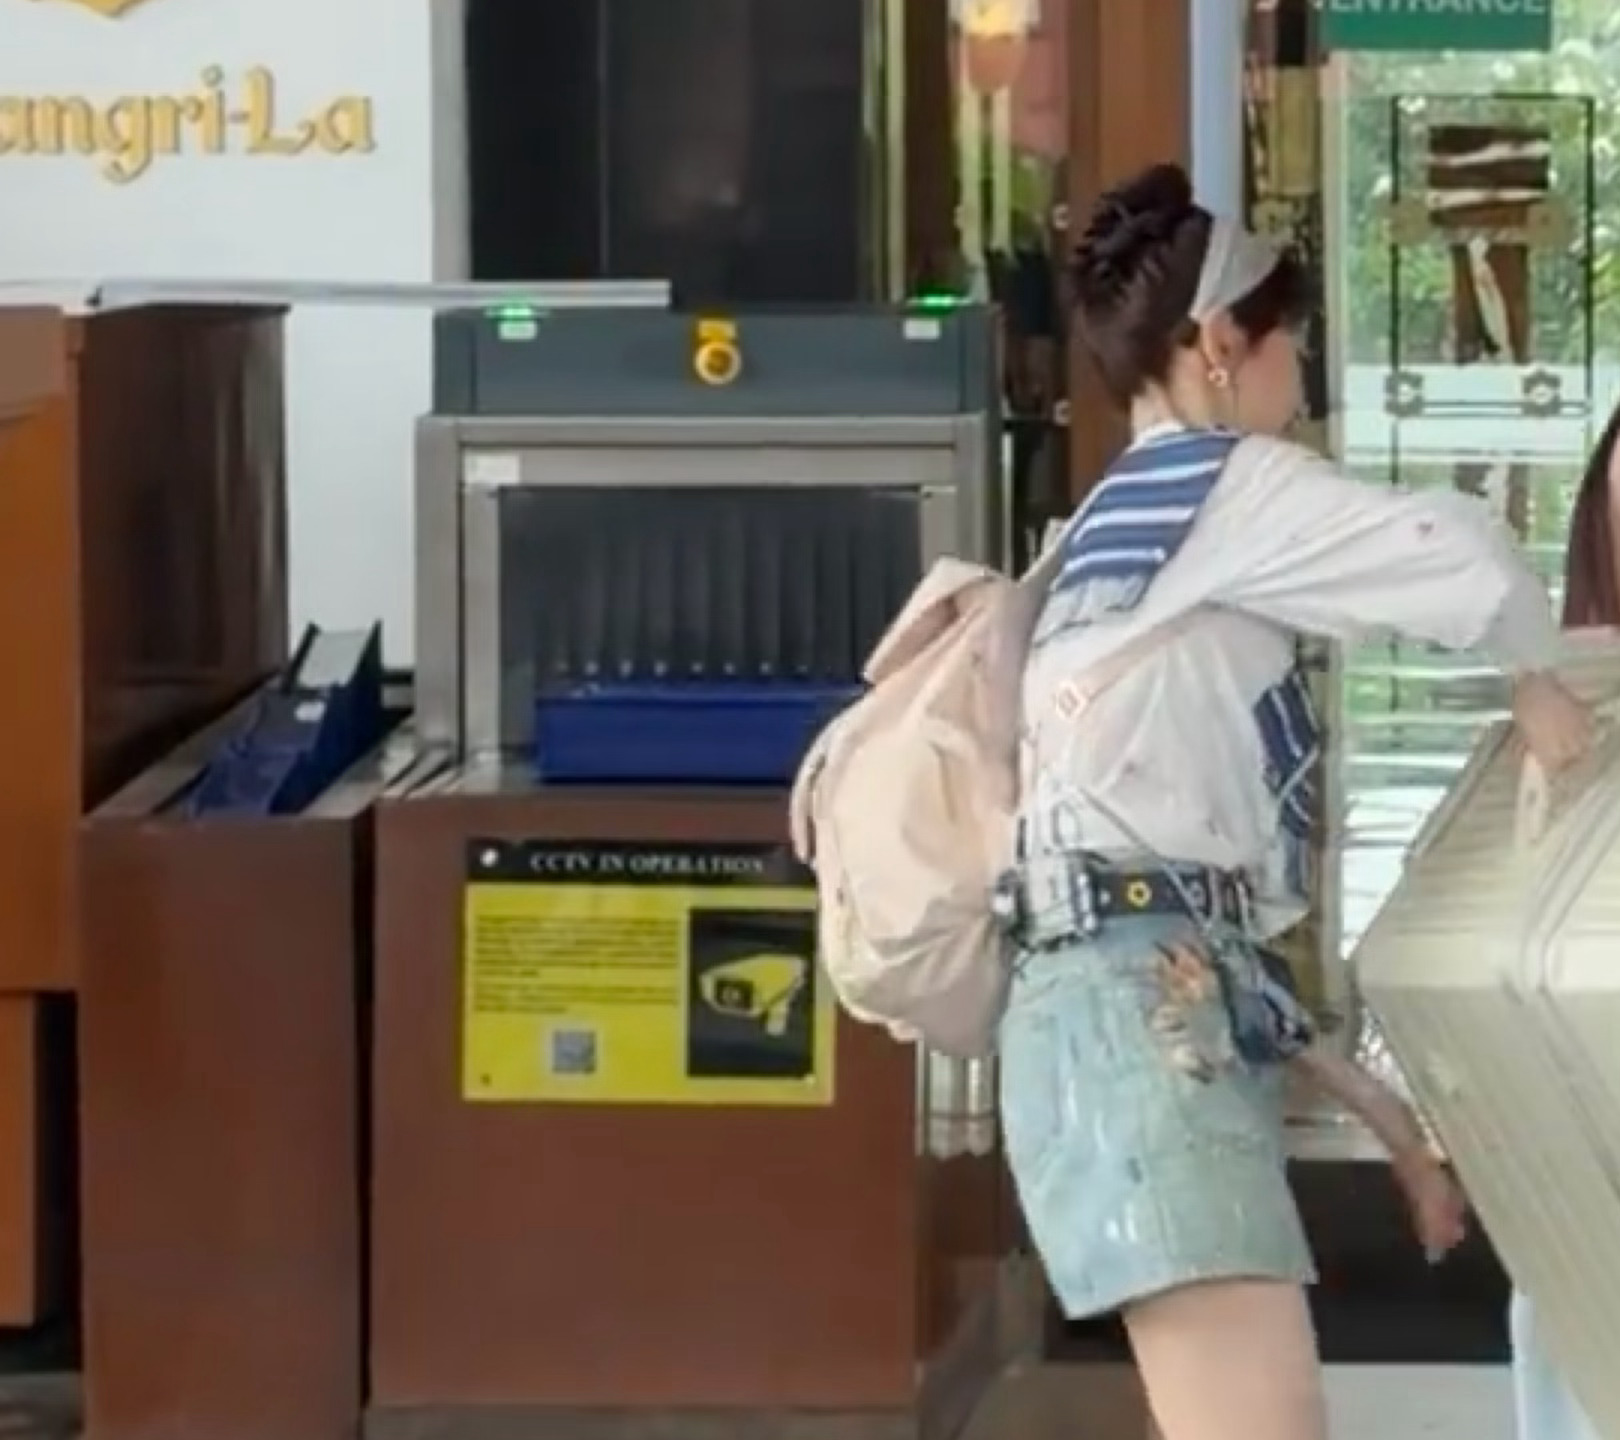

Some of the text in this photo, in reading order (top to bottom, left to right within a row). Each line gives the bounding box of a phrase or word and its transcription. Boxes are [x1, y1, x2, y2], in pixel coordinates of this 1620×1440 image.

[529, 853, 764, 875] CCTV IN OPERATION
